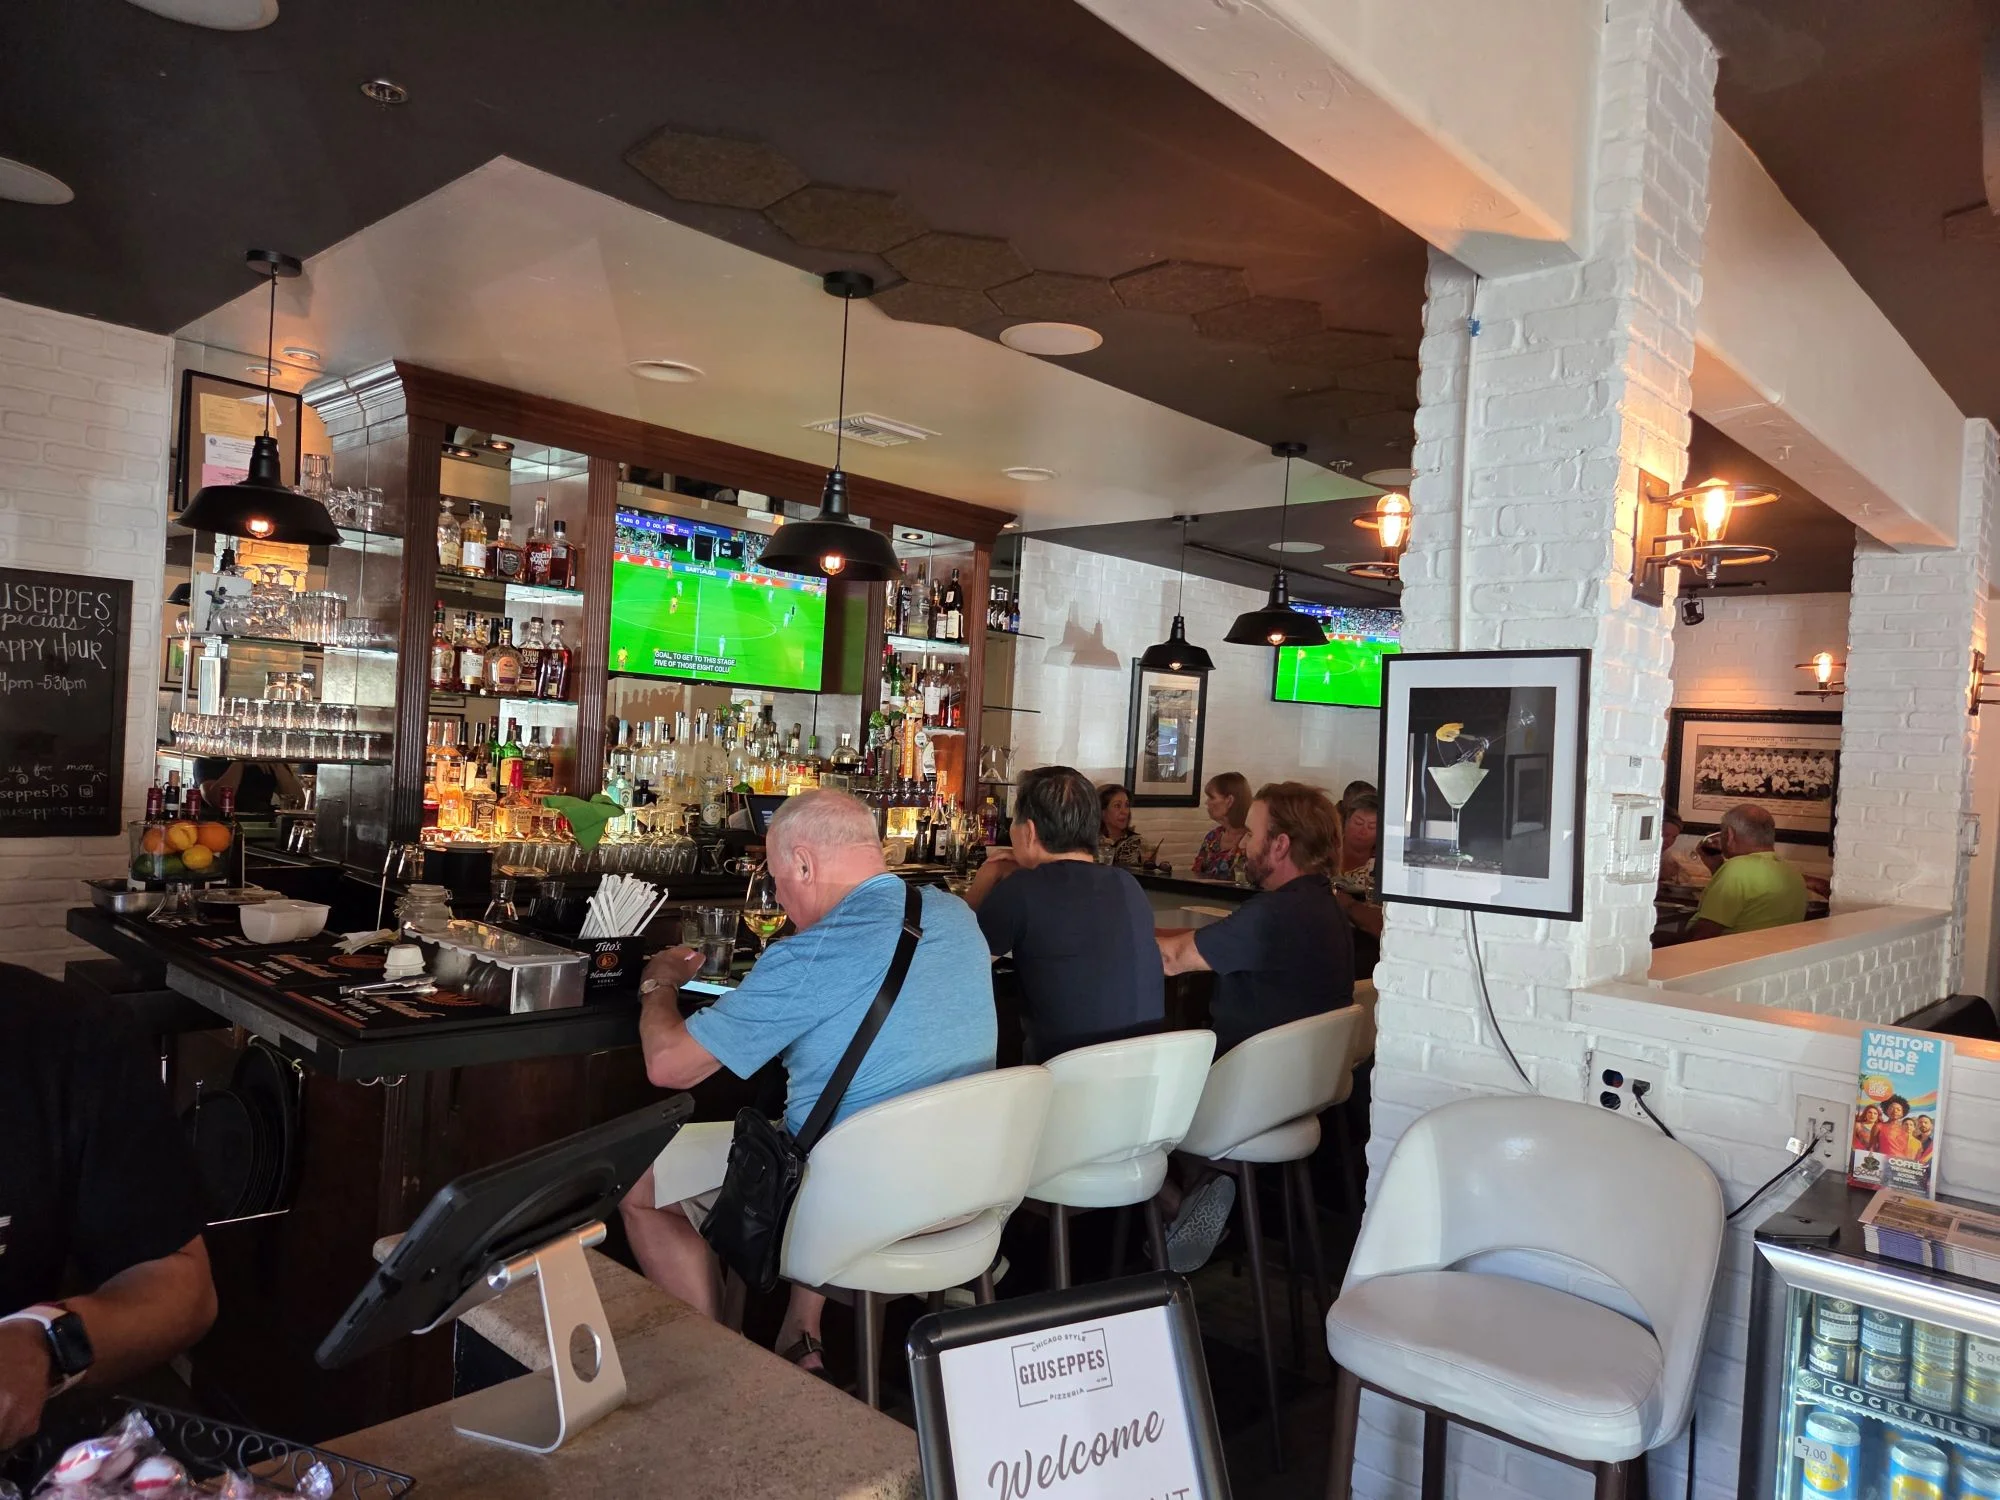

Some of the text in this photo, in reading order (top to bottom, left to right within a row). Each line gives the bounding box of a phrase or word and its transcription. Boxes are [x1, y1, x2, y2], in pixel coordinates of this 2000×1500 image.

[654, 659, 668, 667] FIVE
[668, 660, 677, 668] OF
[677, 661, 697, 670] THOSE
[673, 652, 681, 660] TO
[682, 654, 693, 662] GET
[694, 655, 703, 663] TO
[703, 656, 717, 664] THIS
[1868, 1032, 1935, 1054] VISITOR
[1867, 1045, 1920, 1064] MAP &
[1866, 1057, 1916, 1076] GUIDE
[1031, 1333, 1087, 1352] CHICAGO STYLE
[1019, 1349, 1105, 1385] GIUSEPPES
[1049, 1387, 1085, 1400] PIZZERIA
[1831, 1384, 1982, 1440] COCKTAILS
[987, 1410, 1165, 1500] Welcome
